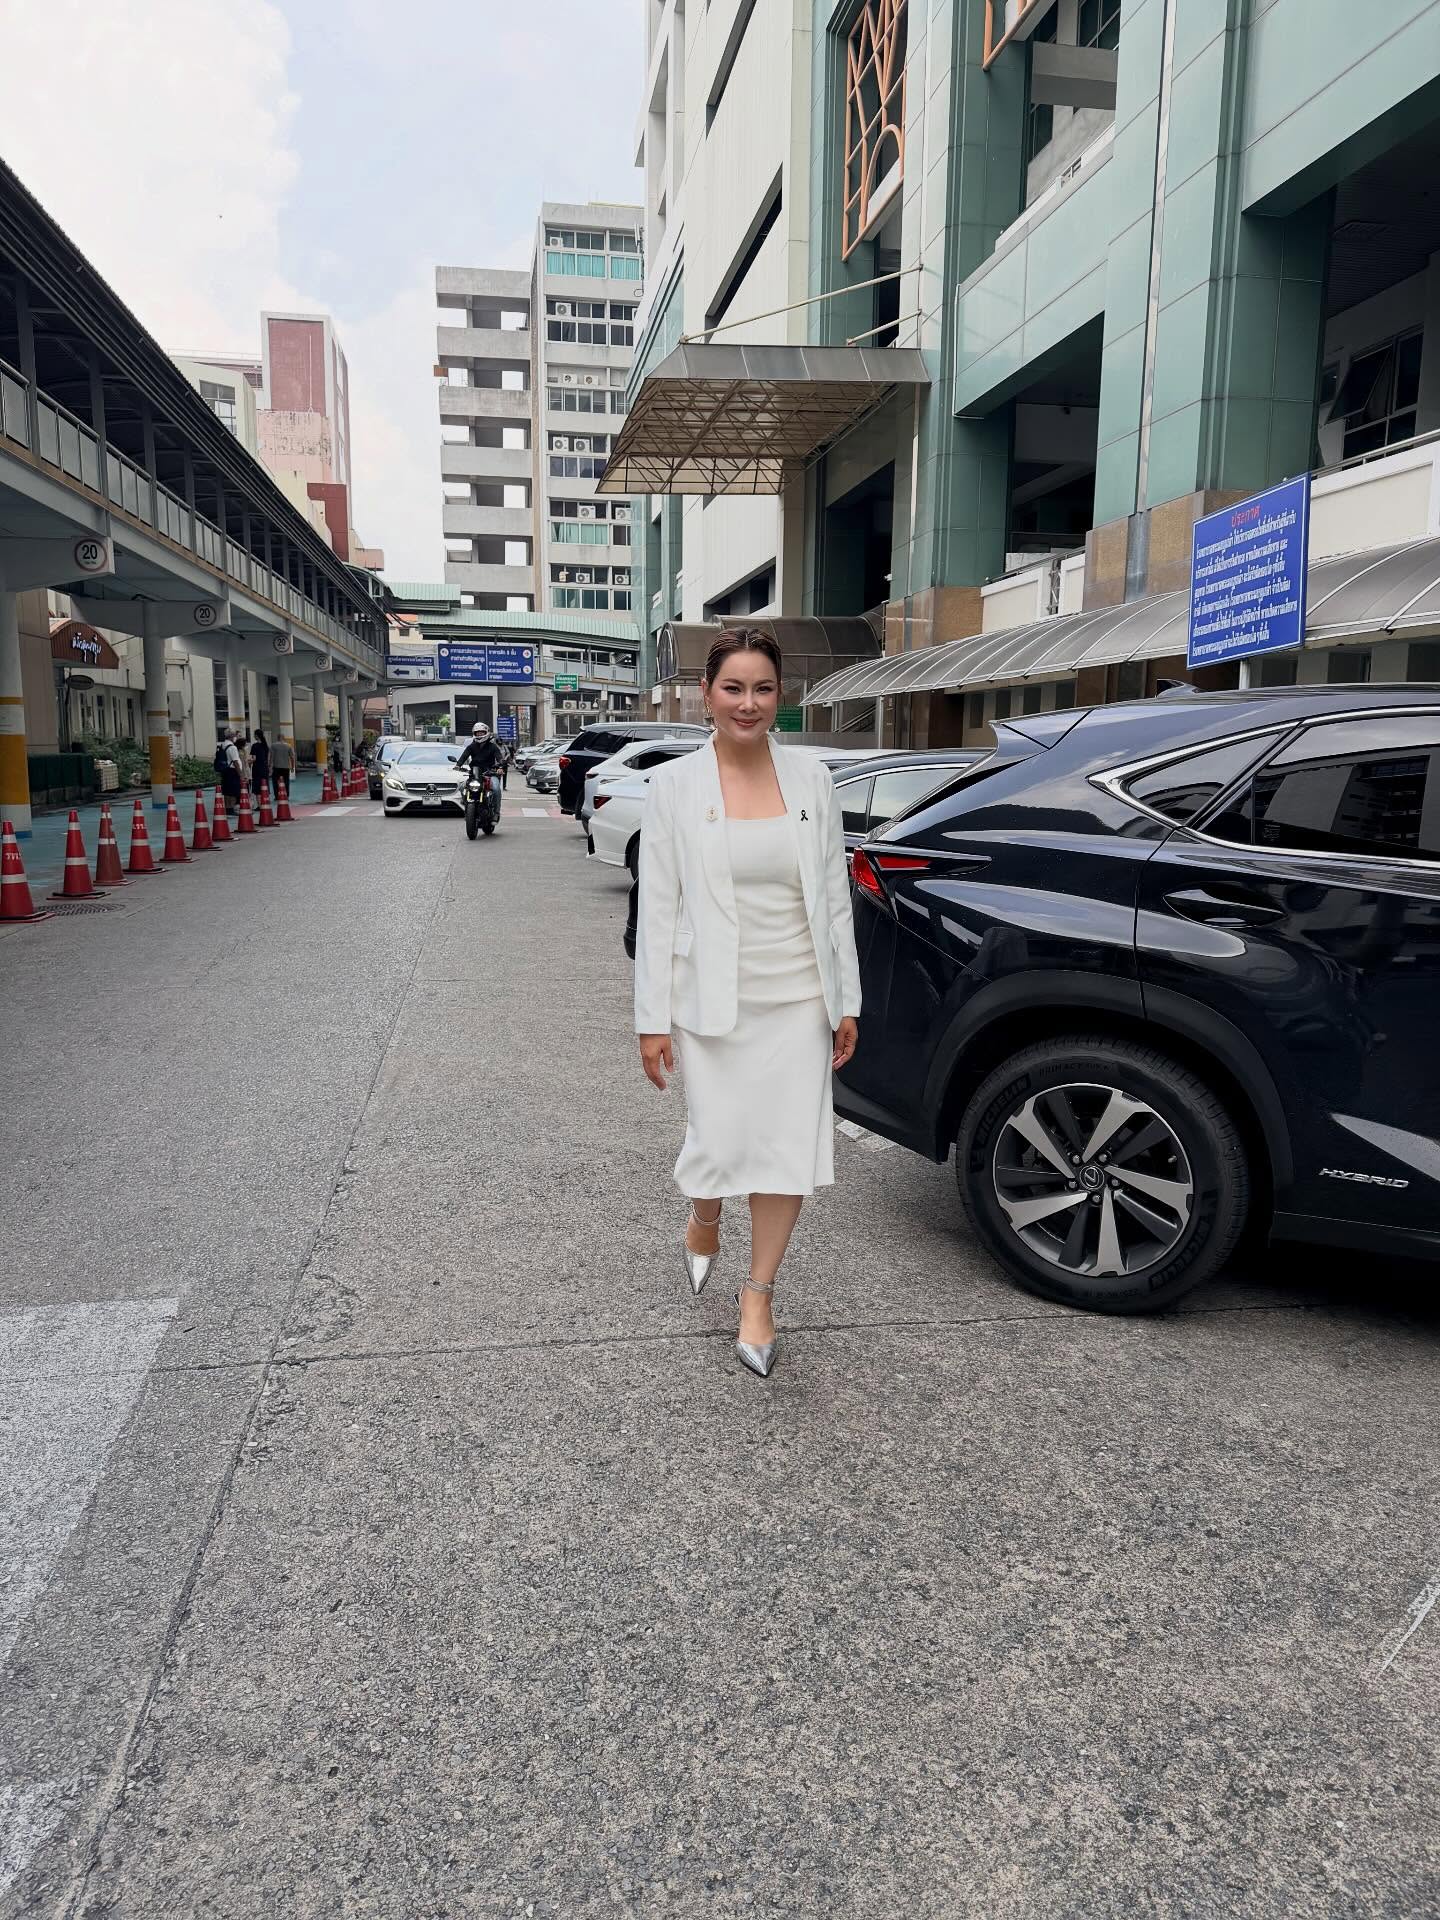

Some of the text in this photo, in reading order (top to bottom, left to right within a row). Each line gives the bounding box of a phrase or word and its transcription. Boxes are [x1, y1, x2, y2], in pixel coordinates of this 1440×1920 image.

[1232, 506, 1260, 527] ประกาศ
[82, 544, 98, 560] 20
[199, 608, 210, 618] 20
[277, 638, 286, 646] 20
[976, 1075, 1028, 1146] MICHELIN
[1318, 1168, 1409, 1188] HYBRID
